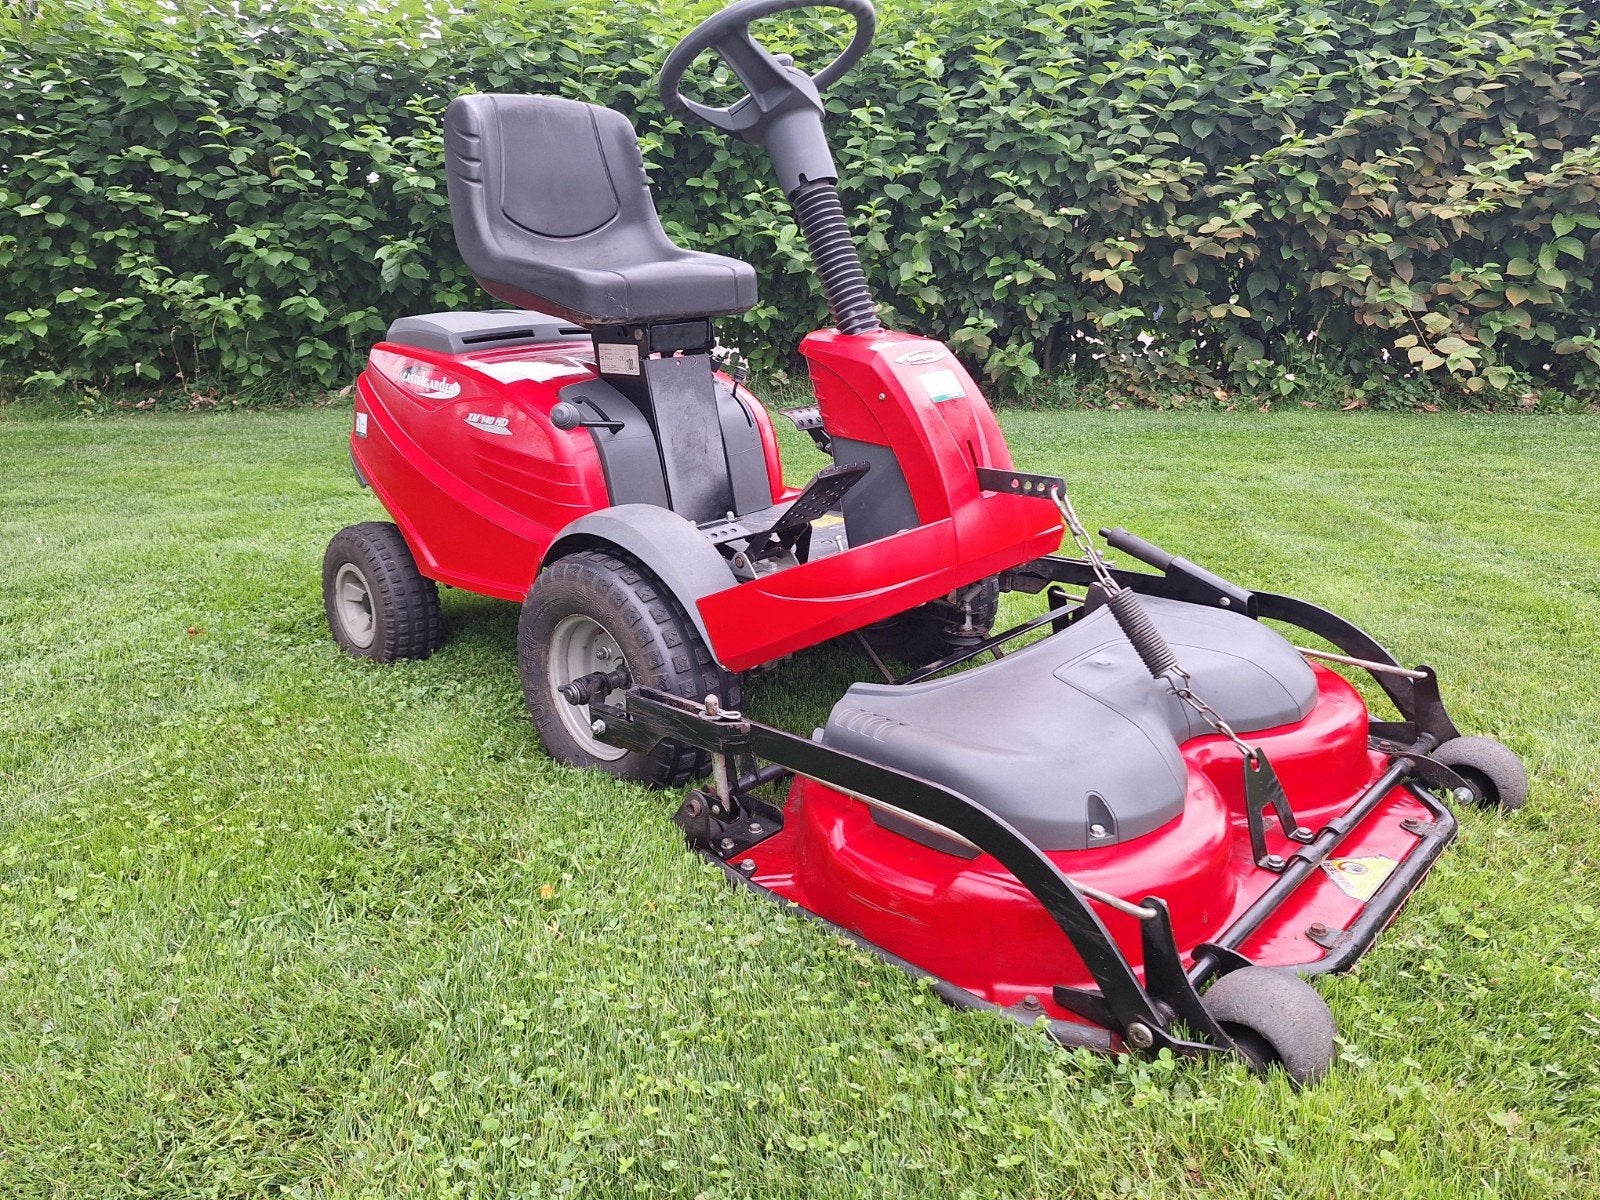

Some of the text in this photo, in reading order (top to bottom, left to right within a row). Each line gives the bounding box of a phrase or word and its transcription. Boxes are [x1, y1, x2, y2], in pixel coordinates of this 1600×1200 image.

[466, 412, 509, 427] XM 140 HD
[525, 678, 551, 731] TURF
